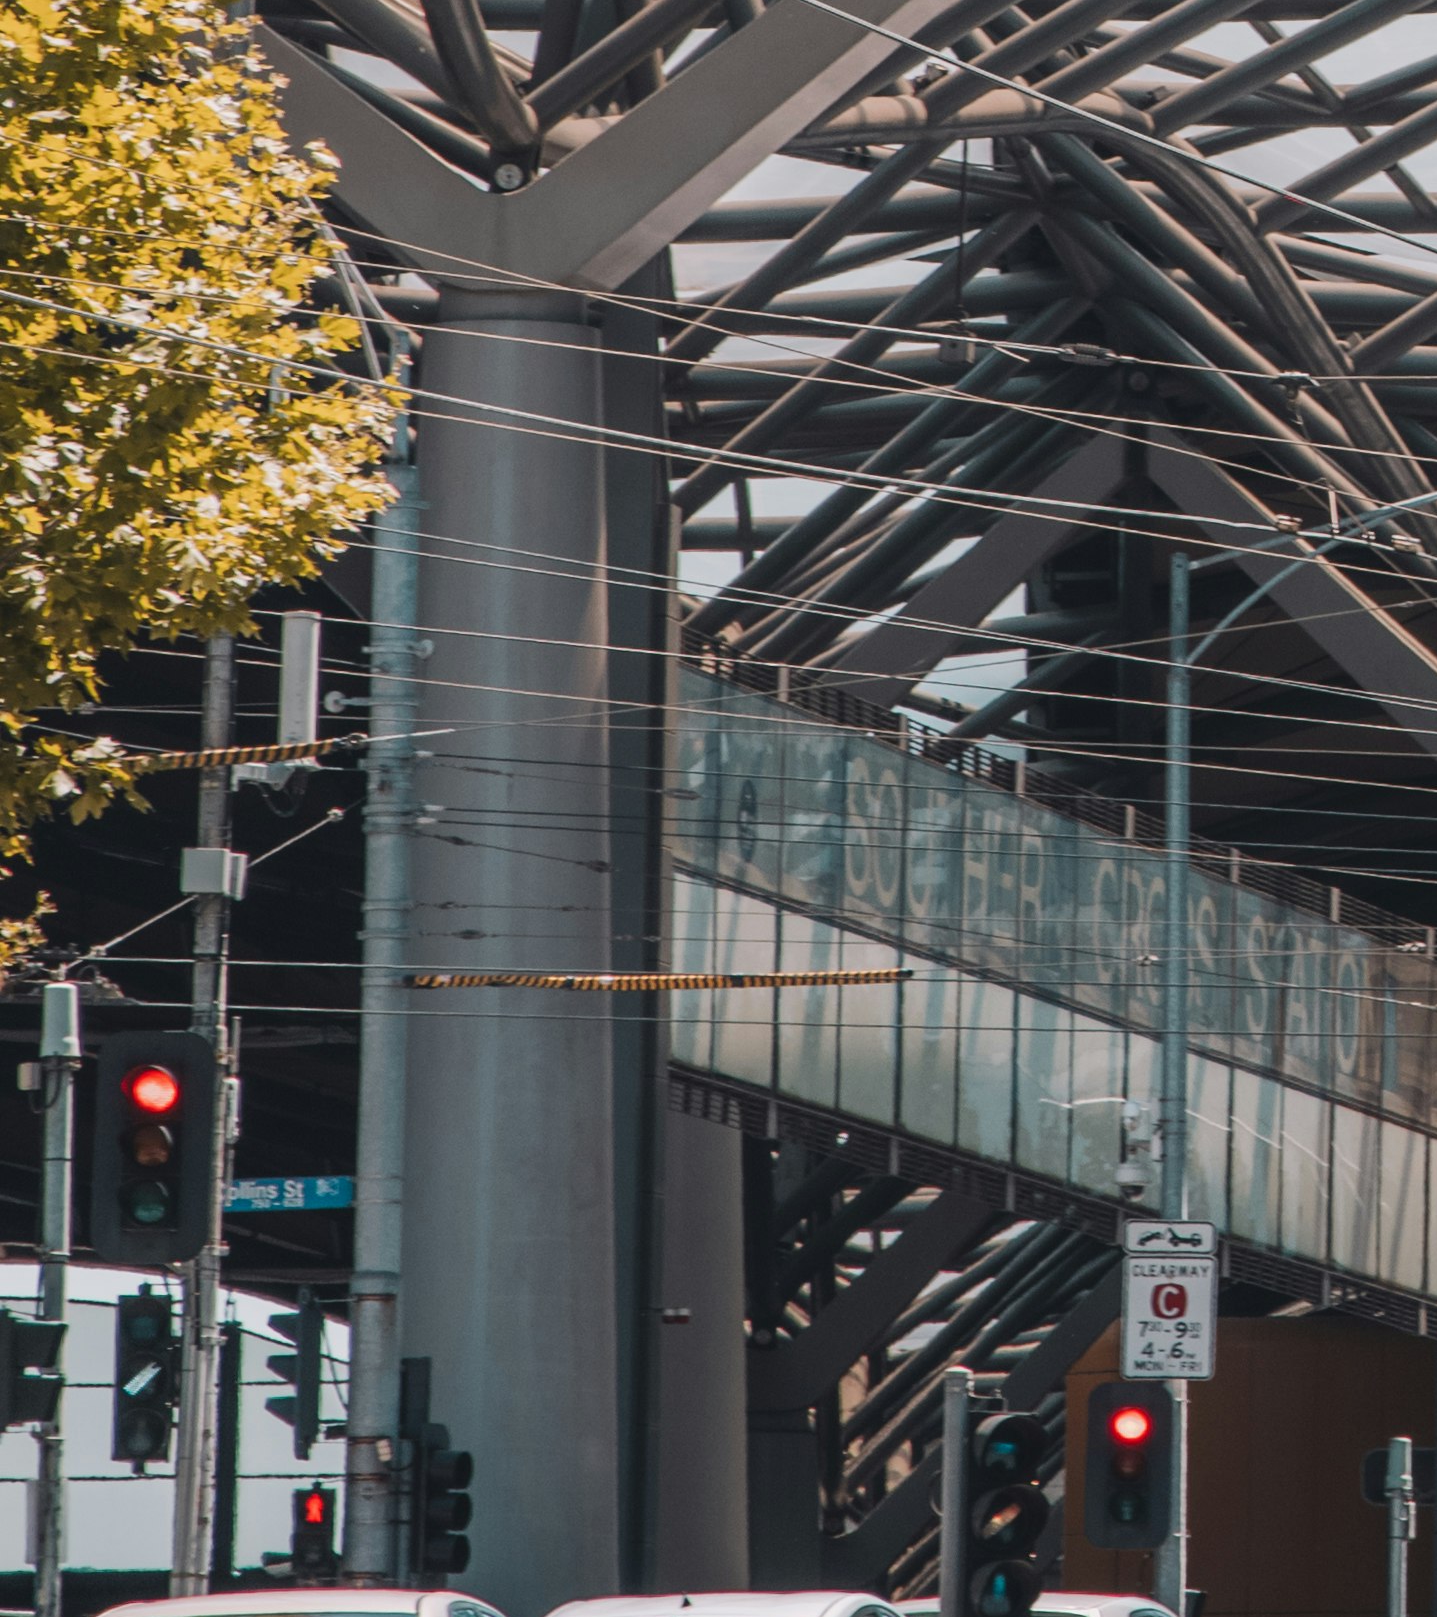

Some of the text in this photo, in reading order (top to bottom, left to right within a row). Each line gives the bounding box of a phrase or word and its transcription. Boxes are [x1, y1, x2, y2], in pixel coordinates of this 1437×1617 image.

[282, 1179, 305, 1199] St
[1132, 1265, 1209, 1277] CLEARWAY
[1158, 1285, 1180, 1317] C
